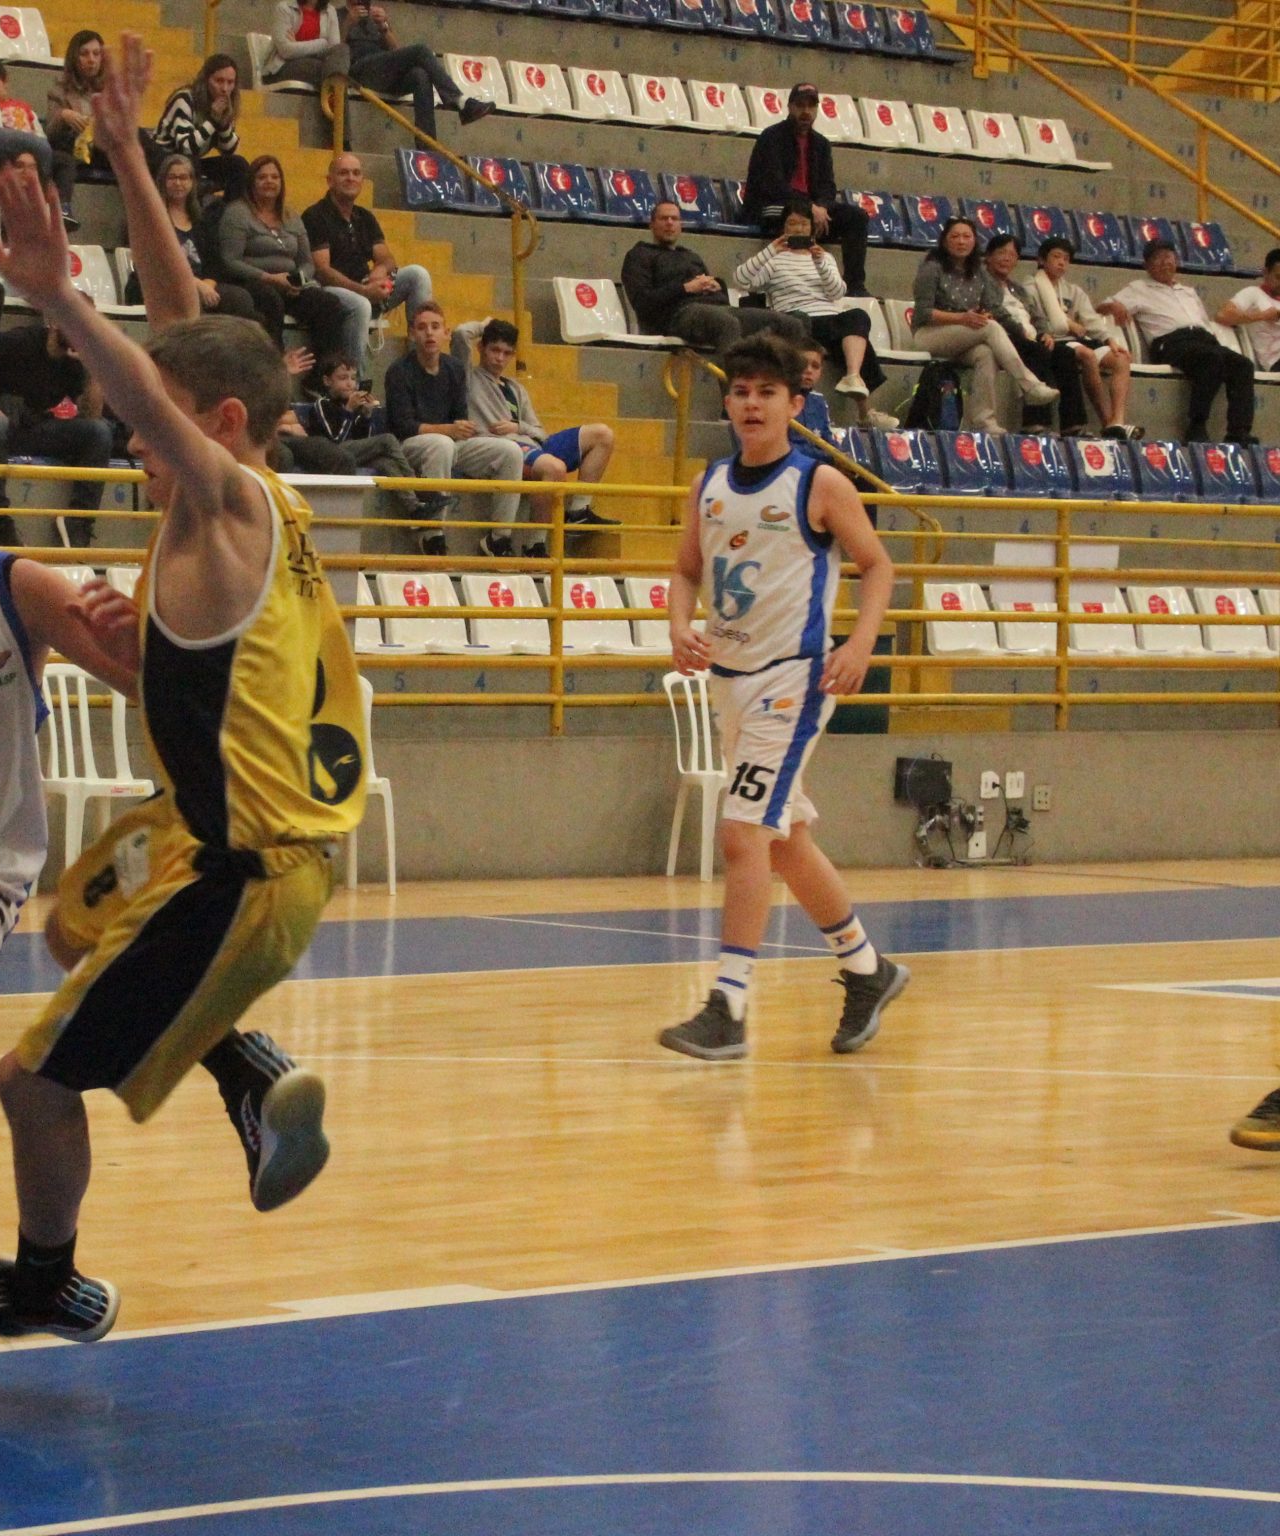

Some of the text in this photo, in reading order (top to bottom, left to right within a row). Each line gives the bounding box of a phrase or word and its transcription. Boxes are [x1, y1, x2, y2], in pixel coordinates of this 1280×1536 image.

[888, 513, 899, 531] 2
[955, 515, 966, 532] 3
[1019, 518, 1030, 533] 4
[1149, 523, 1160, 539] 6
[393, 671, 406, 692] 5
[474, 671, 487, 690] 4
[563, 671, 576, 692] 3
[644, 671, 656, 692] 2
[729, 762, 776, 802] 15
